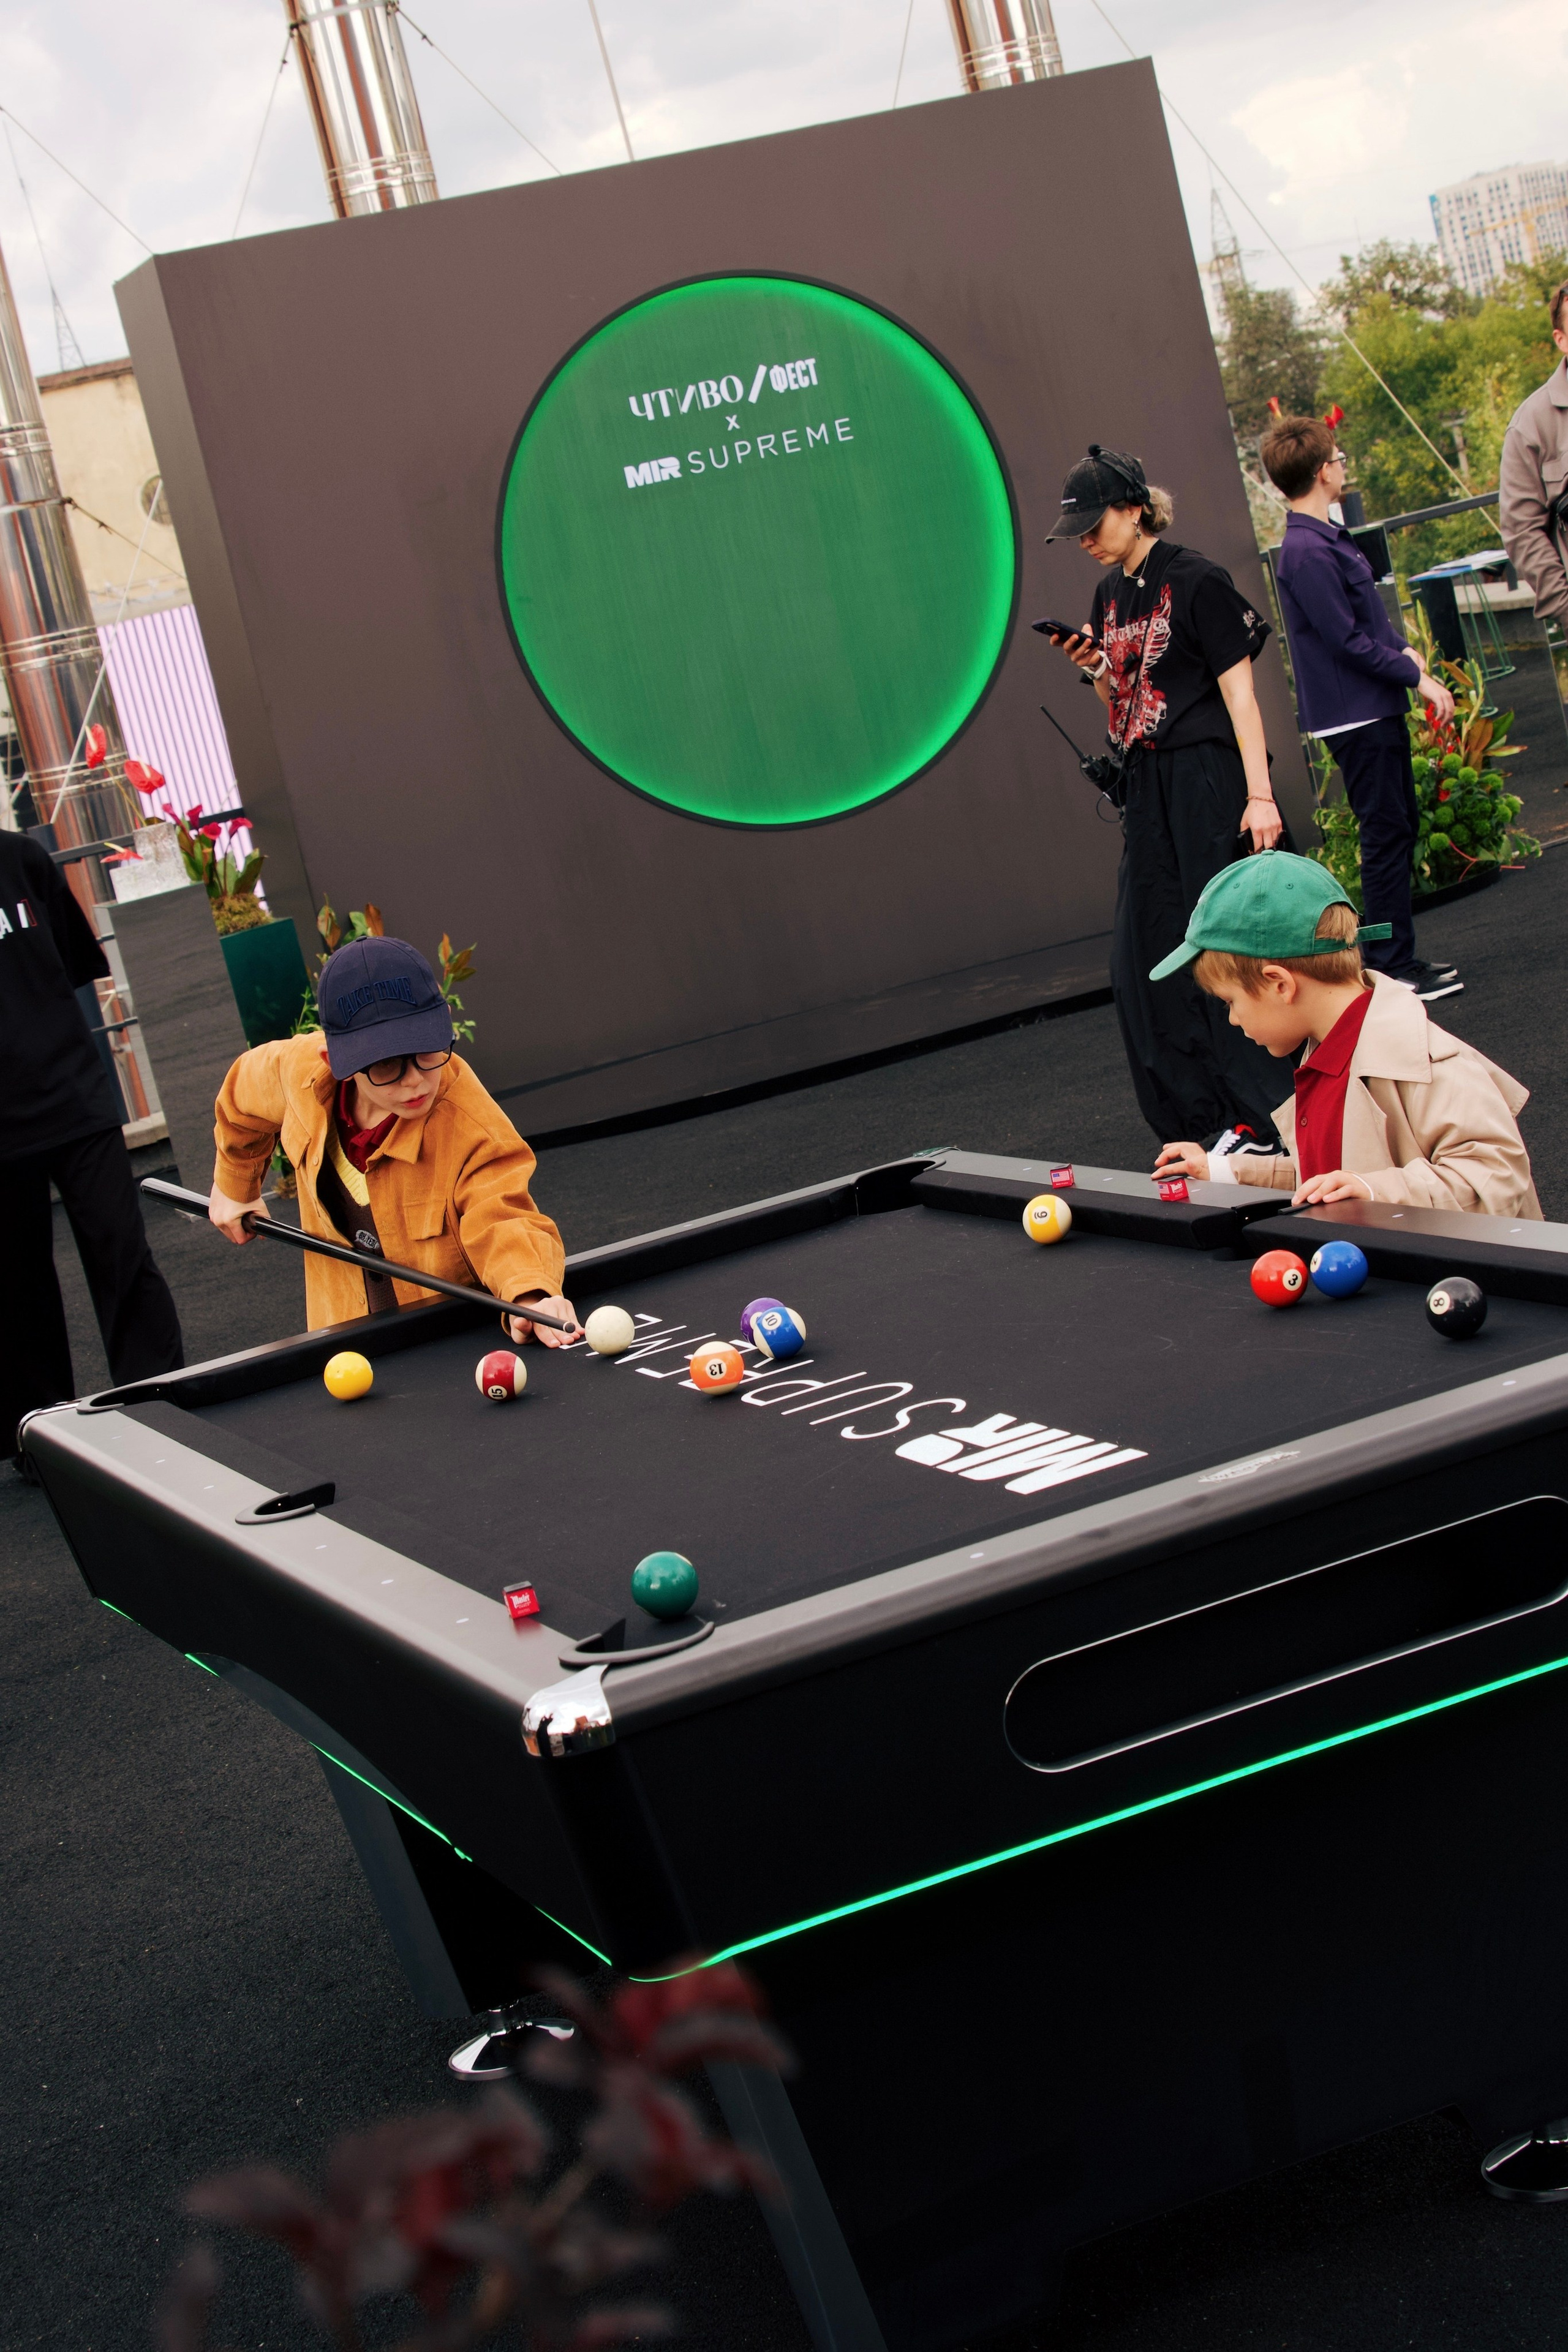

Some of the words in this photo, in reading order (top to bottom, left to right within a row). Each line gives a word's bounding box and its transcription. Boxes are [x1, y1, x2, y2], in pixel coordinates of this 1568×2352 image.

[624, 456, 682, 489] MIR
[687, 418, 854, 473] SUPREME
[337, 985, 374, 1027] TAKE
[373, 976, 417, 1005] TIME
[1288, 1274, 1298, 1286] 3
[1433, 1297, 1445, 1307] 8
[765, 1314, 778, 1327] 10
[709, 1363, 724, 1376] 13
[491, 1388, 503, 1398] 15
[895, 1412, 1149, 1495] MIR
